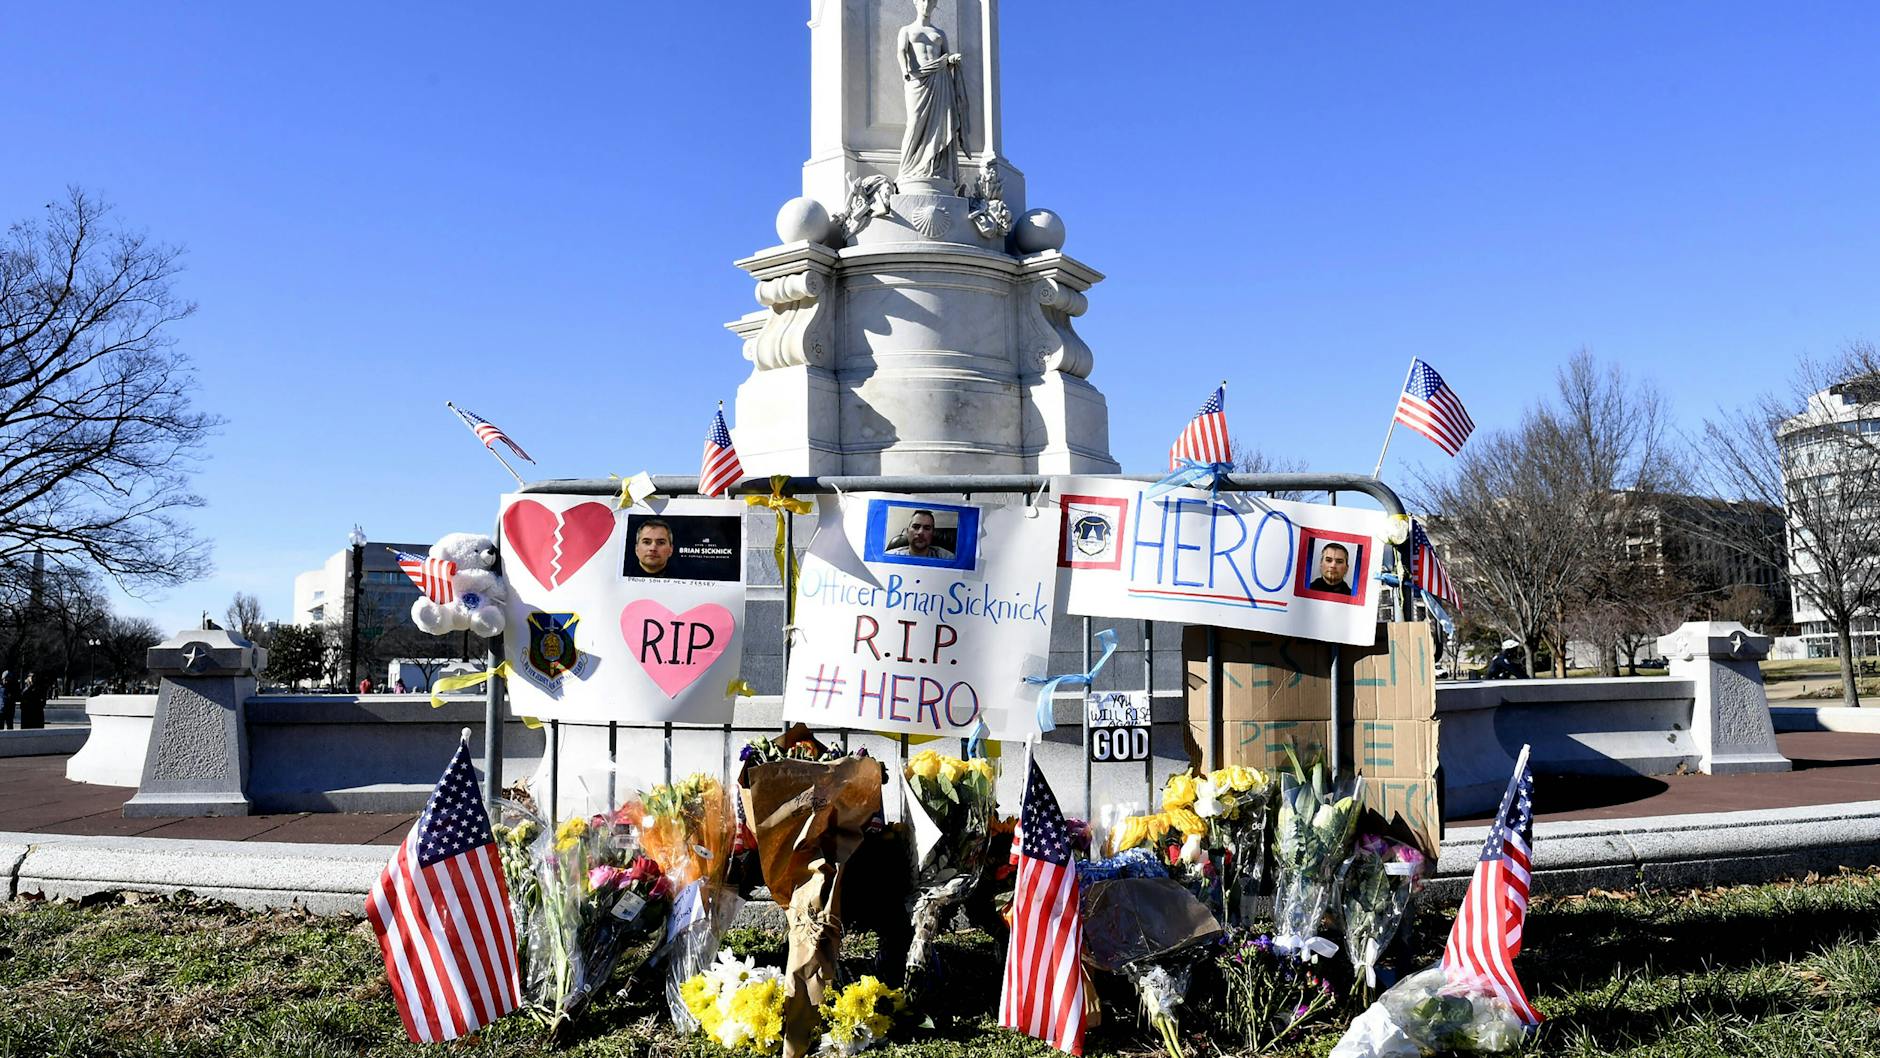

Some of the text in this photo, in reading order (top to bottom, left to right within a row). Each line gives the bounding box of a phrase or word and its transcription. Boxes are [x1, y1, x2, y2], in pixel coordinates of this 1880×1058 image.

[701, 547, 732, 555] SICKNICK
[1131, 491, 1294, 608] HERO
[802, 567, 1048, 625] Officer Brian Sicknick
[854, 614, 959, 666] R.I.P.
[1093, 728, 1149, 760] GOD
